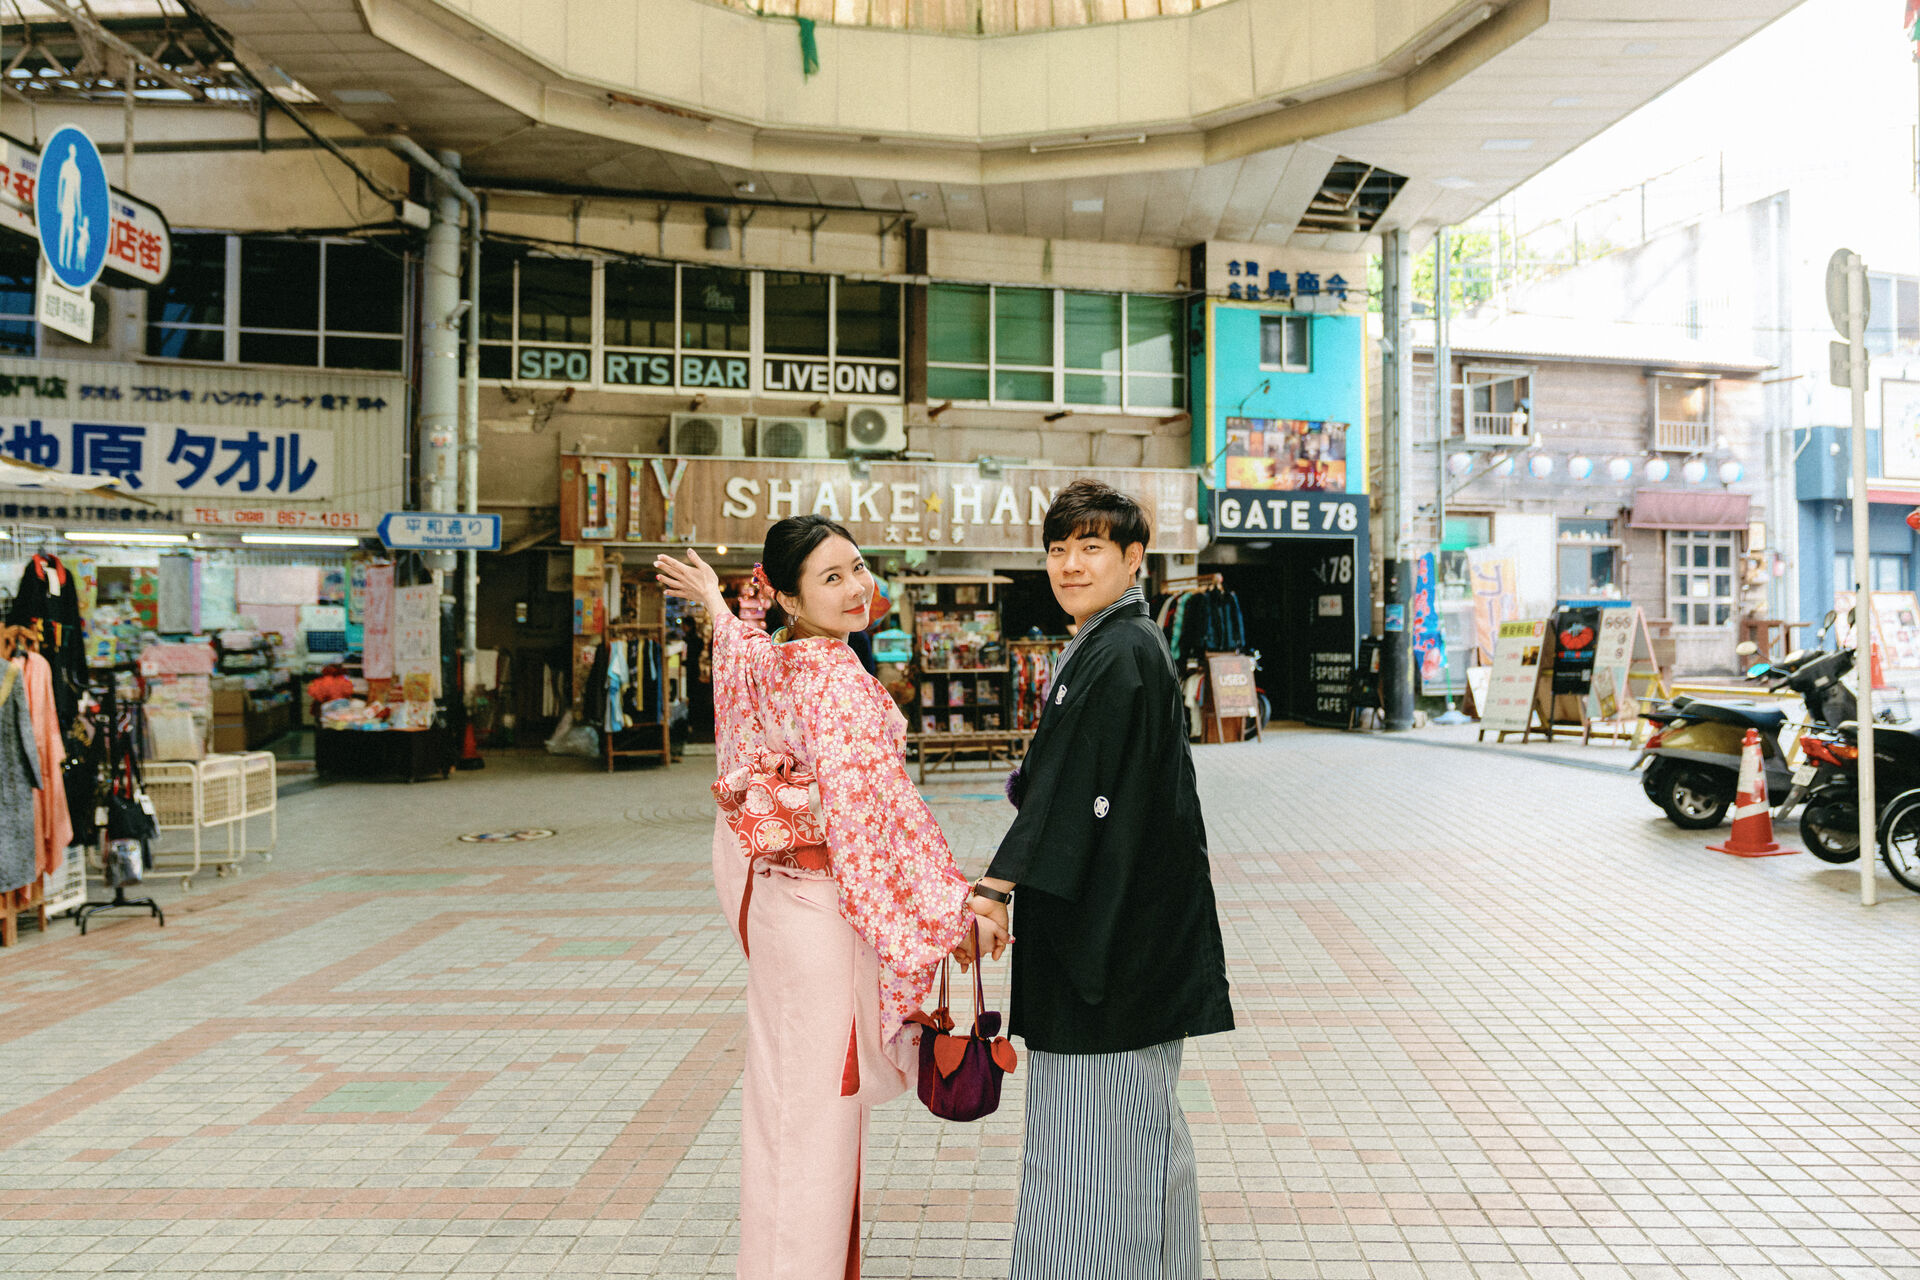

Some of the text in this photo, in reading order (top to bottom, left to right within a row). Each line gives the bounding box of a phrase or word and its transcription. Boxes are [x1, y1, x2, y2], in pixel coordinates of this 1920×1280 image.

[519, 349, 669, 386] SPORTS
[683, 355, 748, 389] BAR
[765, 361, 828, 391] LIVE
[167, 427, 319, 494] タオル
[194, 508, 223, 524] TEL
[580, 457, 689, 543] DIY
[723, 476, 921, 523] SHAKE
[1220, 499, 1310, 532] GATE
[1319, 501, 1359, 532] 78
[406, 519, 482, 536] 平和通り
[1329, 554, 1352, 584] 78
